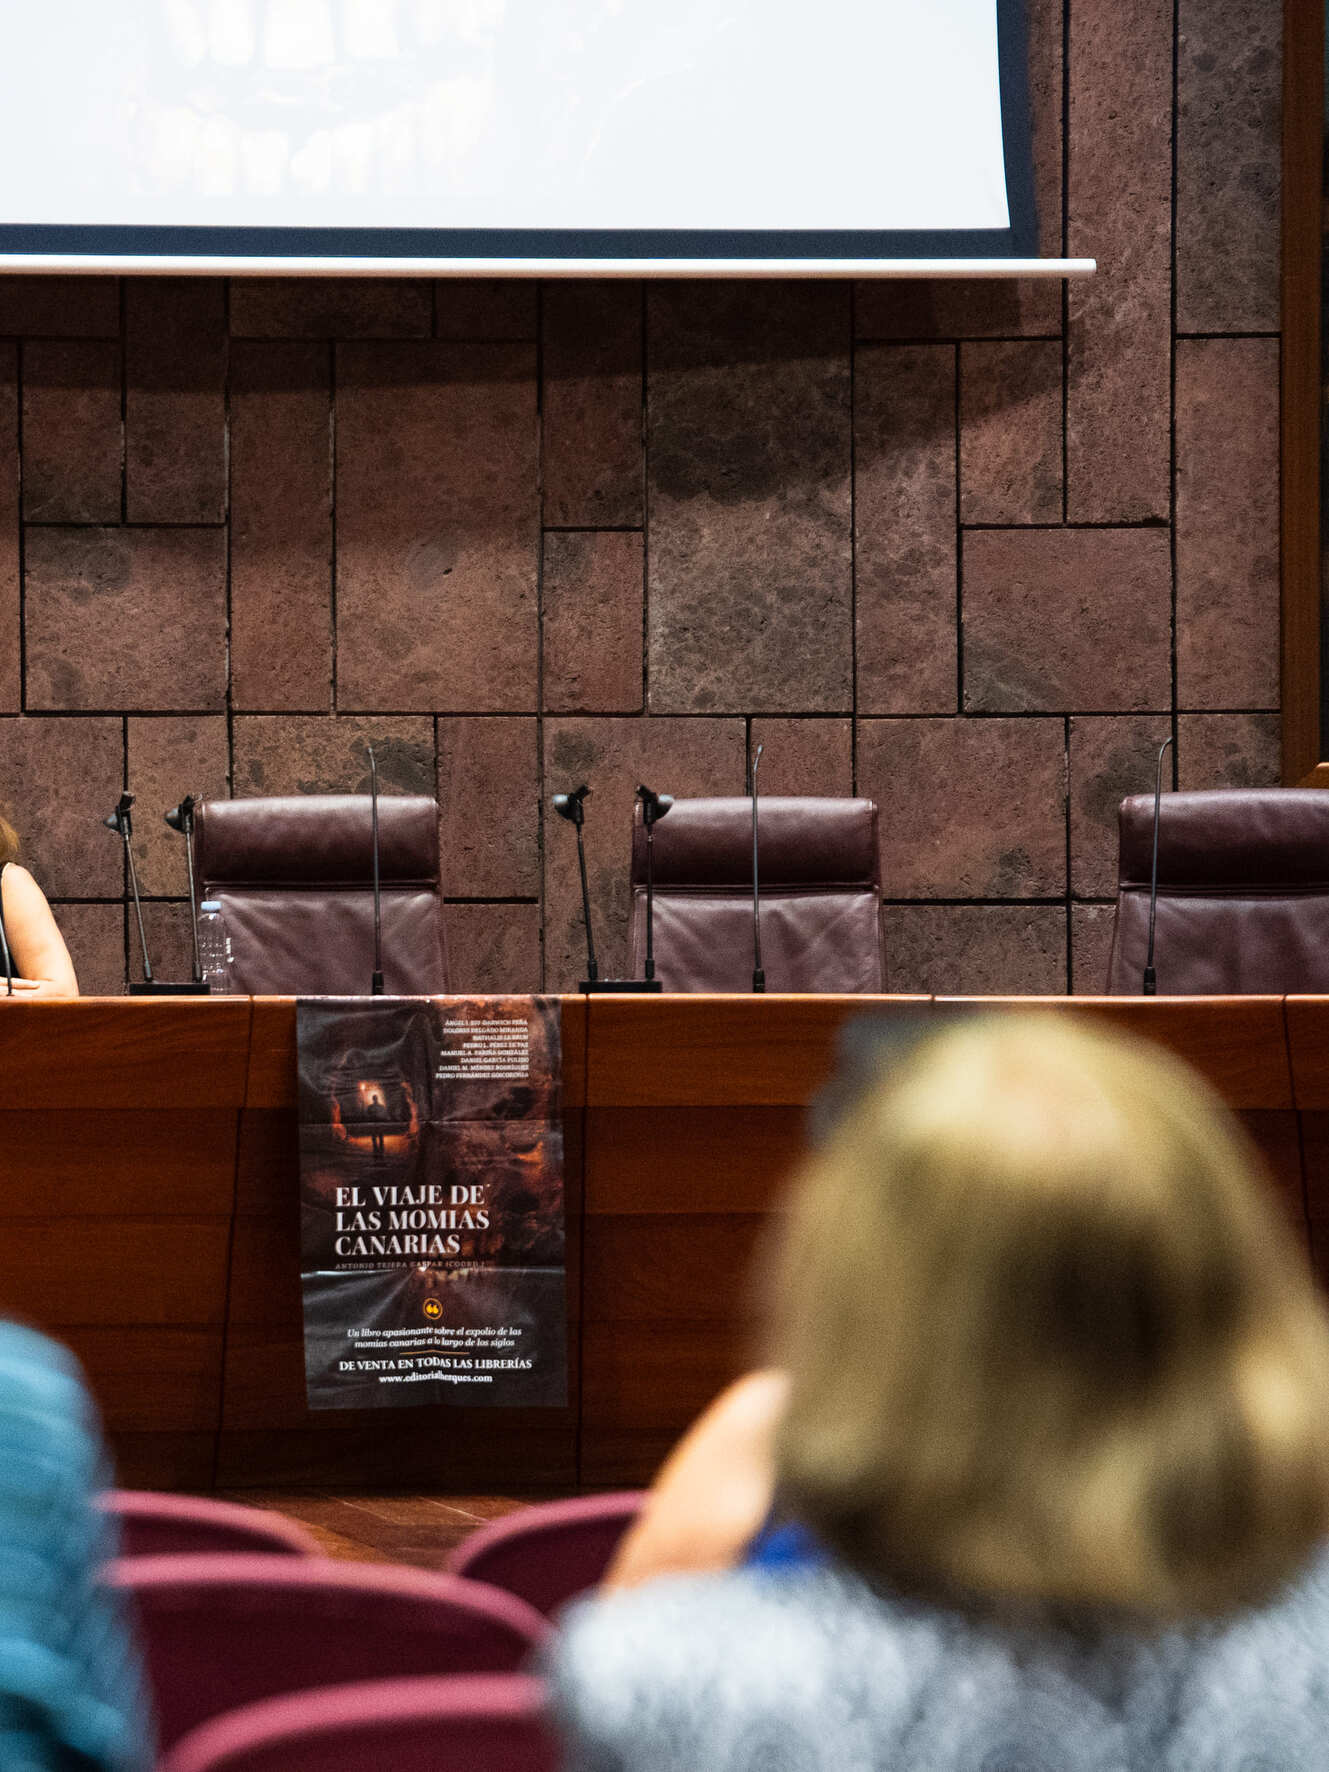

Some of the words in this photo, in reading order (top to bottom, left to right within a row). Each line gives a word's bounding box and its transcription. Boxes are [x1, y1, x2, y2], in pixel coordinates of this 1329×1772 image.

[336, 1187, 366, 1207] EL
[372, 1184, 443, 1206] VIAJE
[450, 1185, 484, 1205] DE
[336, 1211, 382, 1232] LAS
[388, 1209, 490, 1230] MOMIAS
[335, 1234, 461, 1256] CANARIAS
[347, 1328, 360, 1338] Un
[361, 1328, 382, 1337] libro
[382, 1327, 433, 1338] apasionante
[434, 1326, 455, 1335] sobre
[456, 1327, 465, 1335] el
[465, 1327, 496, 1337] expolio
[497, 1327, 508, 1336] de
[509, 1327, 522, 1336] las
[389, 1337, 425, 1347] canarias
[441, 1337, 464, 1348] largo
[465, 1338, 475, 1346] de
[477, 1338, 489, 1346] los
[490, 1338, 515, 1348] siglos
[339, 1361, 356, 1371] DE
[357, 1360, 396, 1370] VENTA
[398, 1359, 414, 1369] EN
[416, 1357, 451, 1368] TODAS
[453, 1359, 472, 1369] LAS
[475, 1357, 532, 1369] LIBRERÍAS
